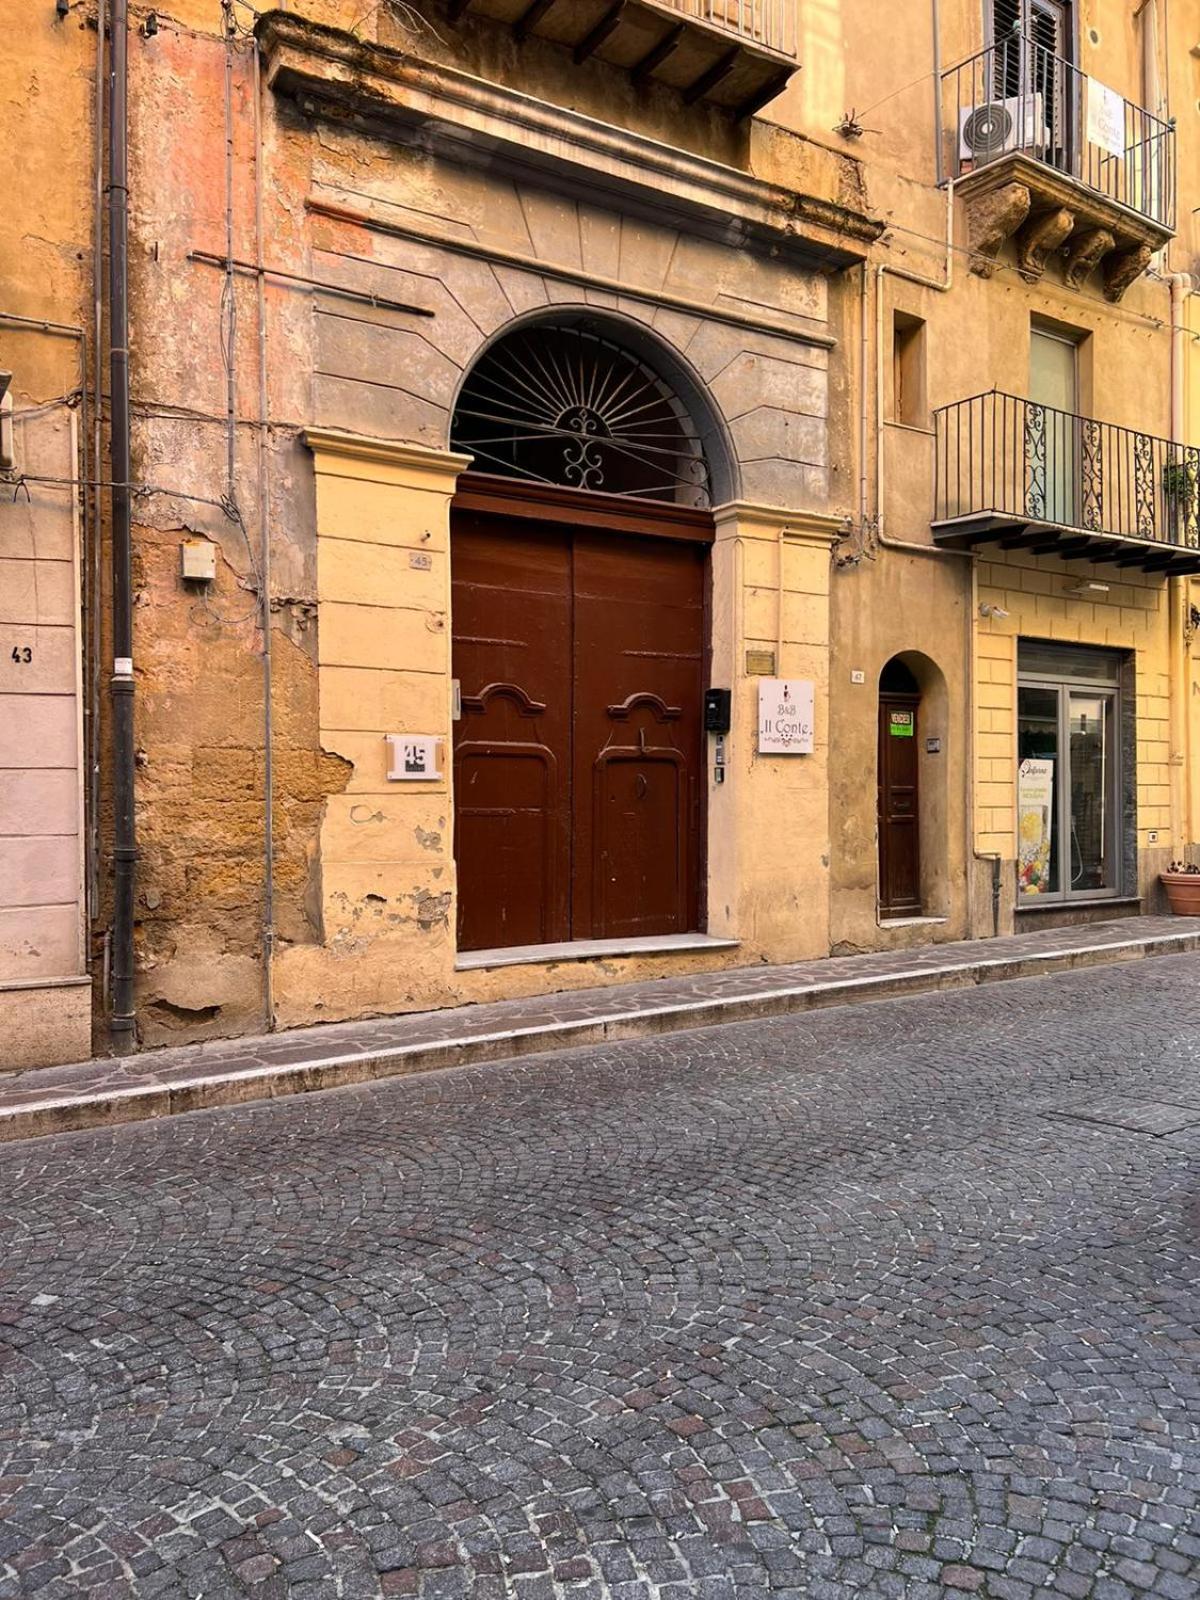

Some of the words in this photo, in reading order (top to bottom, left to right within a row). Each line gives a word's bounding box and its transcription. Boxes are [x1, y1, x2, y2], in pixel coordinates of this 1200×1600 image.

[12, 646, 32, 664] 43
[777, 703, 797, 716] B&B
[765, 719, 772, 733] Il
[775, 718, 809, 735] Conte
[404, 745, 426, 765] 45
